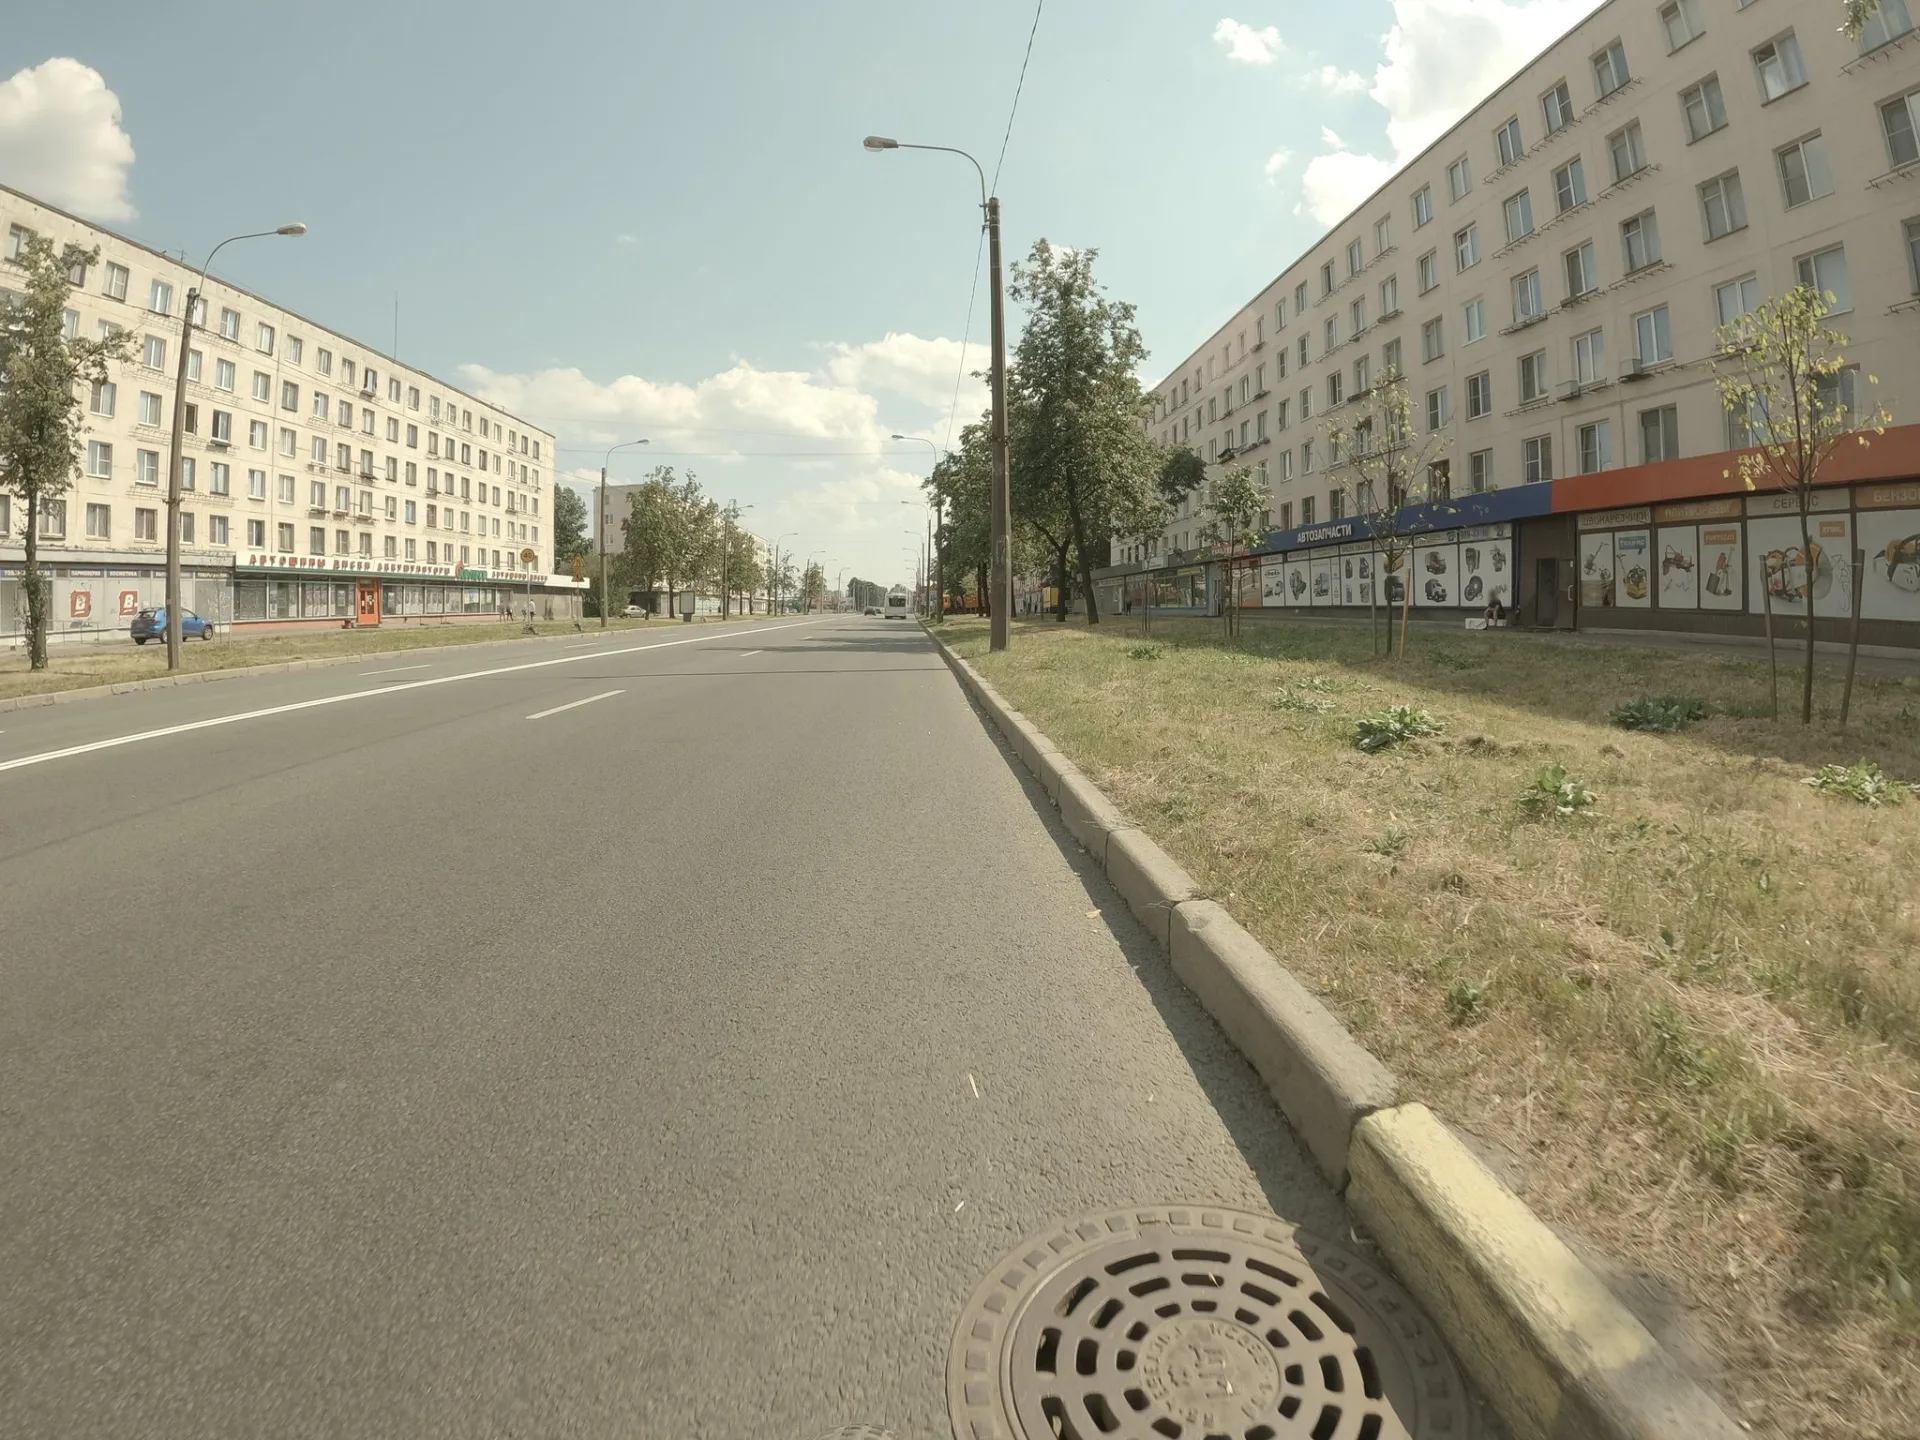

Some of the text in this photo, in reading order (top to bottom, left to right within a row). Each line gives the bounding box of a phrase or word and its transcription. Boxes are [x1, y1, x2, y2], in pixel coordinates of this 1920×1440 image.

[1773, 495, 1819, 509] СЕРВС
[1297, 524, 1352, 544] АВТОЗАПЧАСТИ
[249, 554, 326, 568] АВТОШИНЫ
